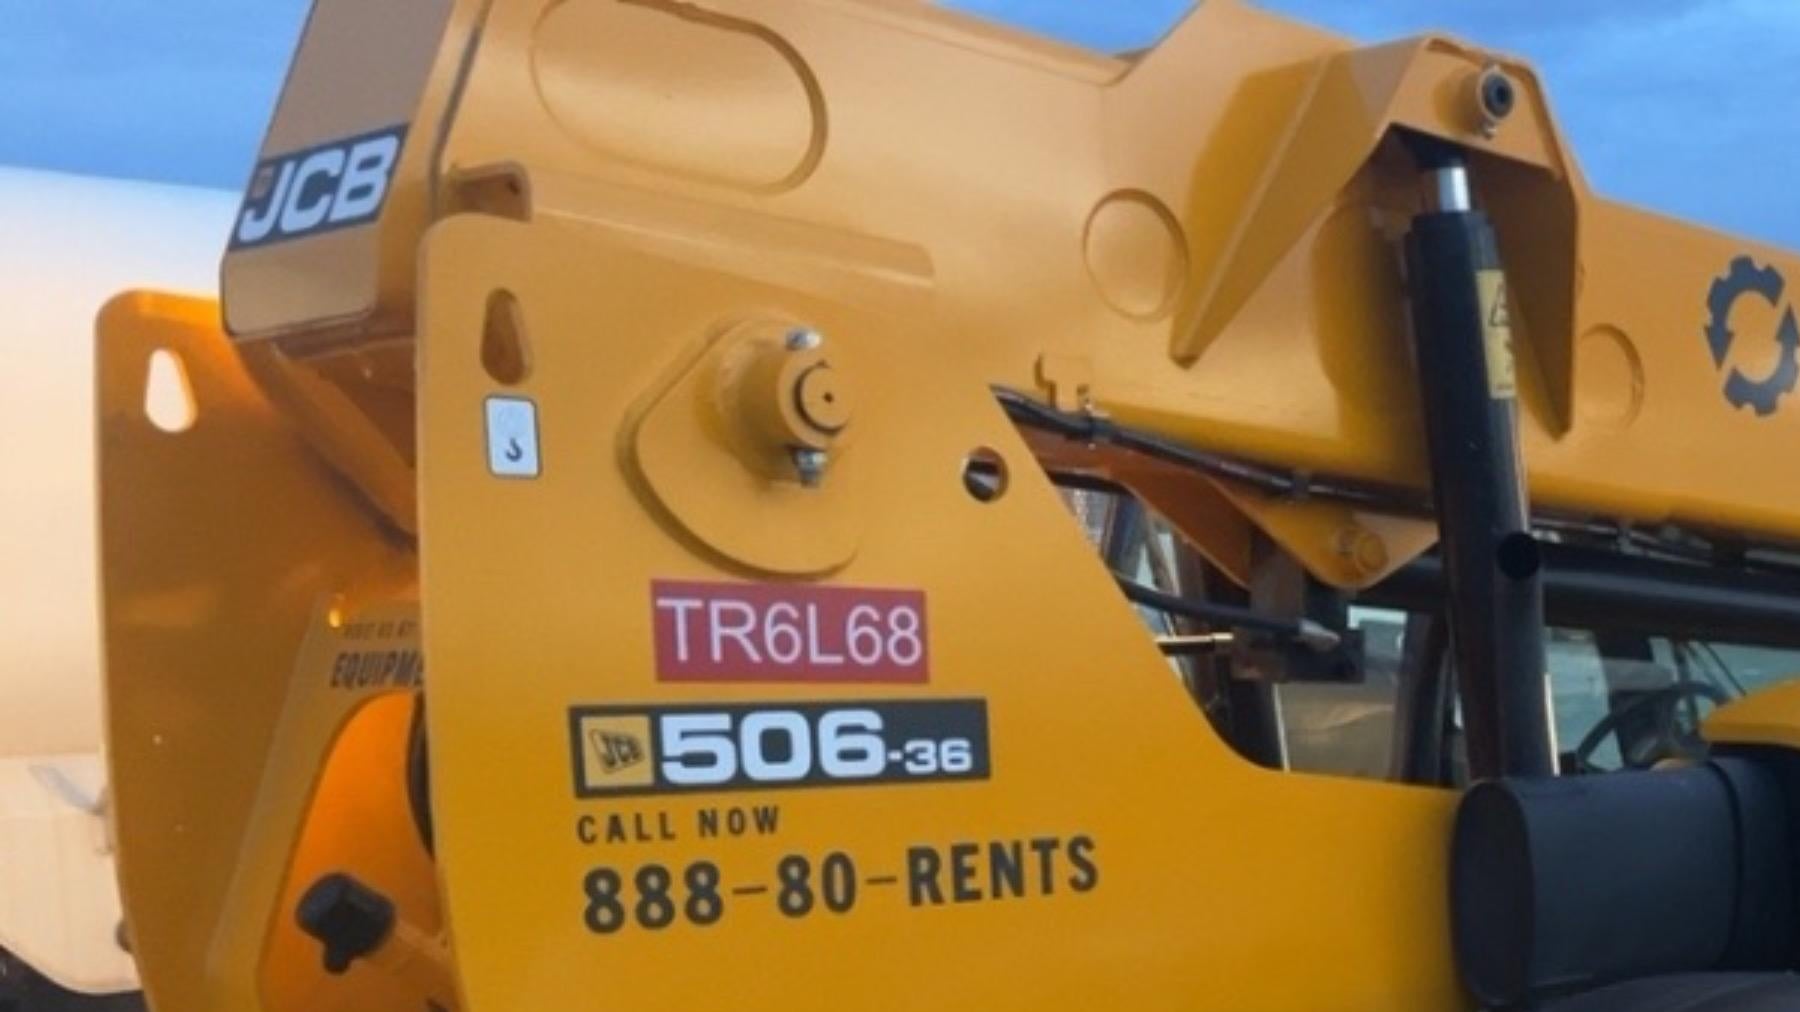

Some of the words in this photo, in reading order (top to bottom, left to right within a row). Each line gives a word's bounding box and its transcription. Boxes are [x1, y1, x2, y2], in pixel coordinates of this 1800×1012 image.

[238, 134, 399, 244] JCB
[656, 598, 923, 666] TR6L68
[659, 708, 974, 786] 506-36
[576, 811, 677, 845] CALL
[698, 805, 781, 839] NOW
[582, 835, 1100, 935] 888-80-RENTS
